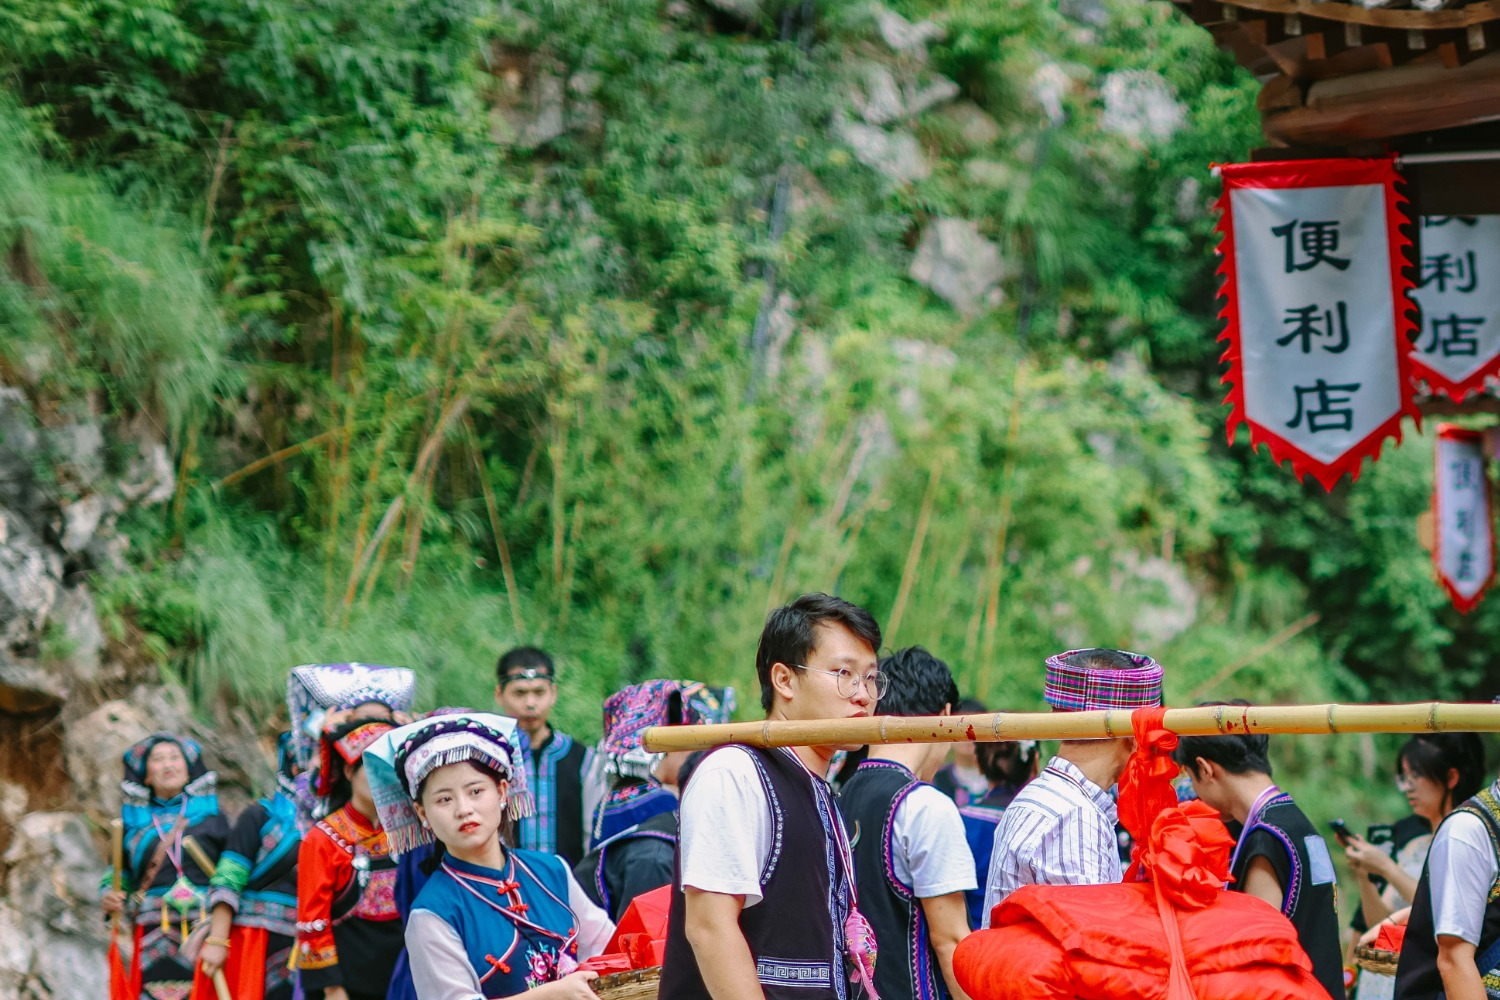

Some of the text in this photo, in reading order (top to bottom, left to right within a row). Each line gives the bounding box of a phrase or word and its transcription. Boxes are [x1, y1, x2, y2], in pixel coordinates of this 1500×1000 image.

[1271, 219, 1361, 433] 便利店
[1421, 216, 1485, 357] 利店
